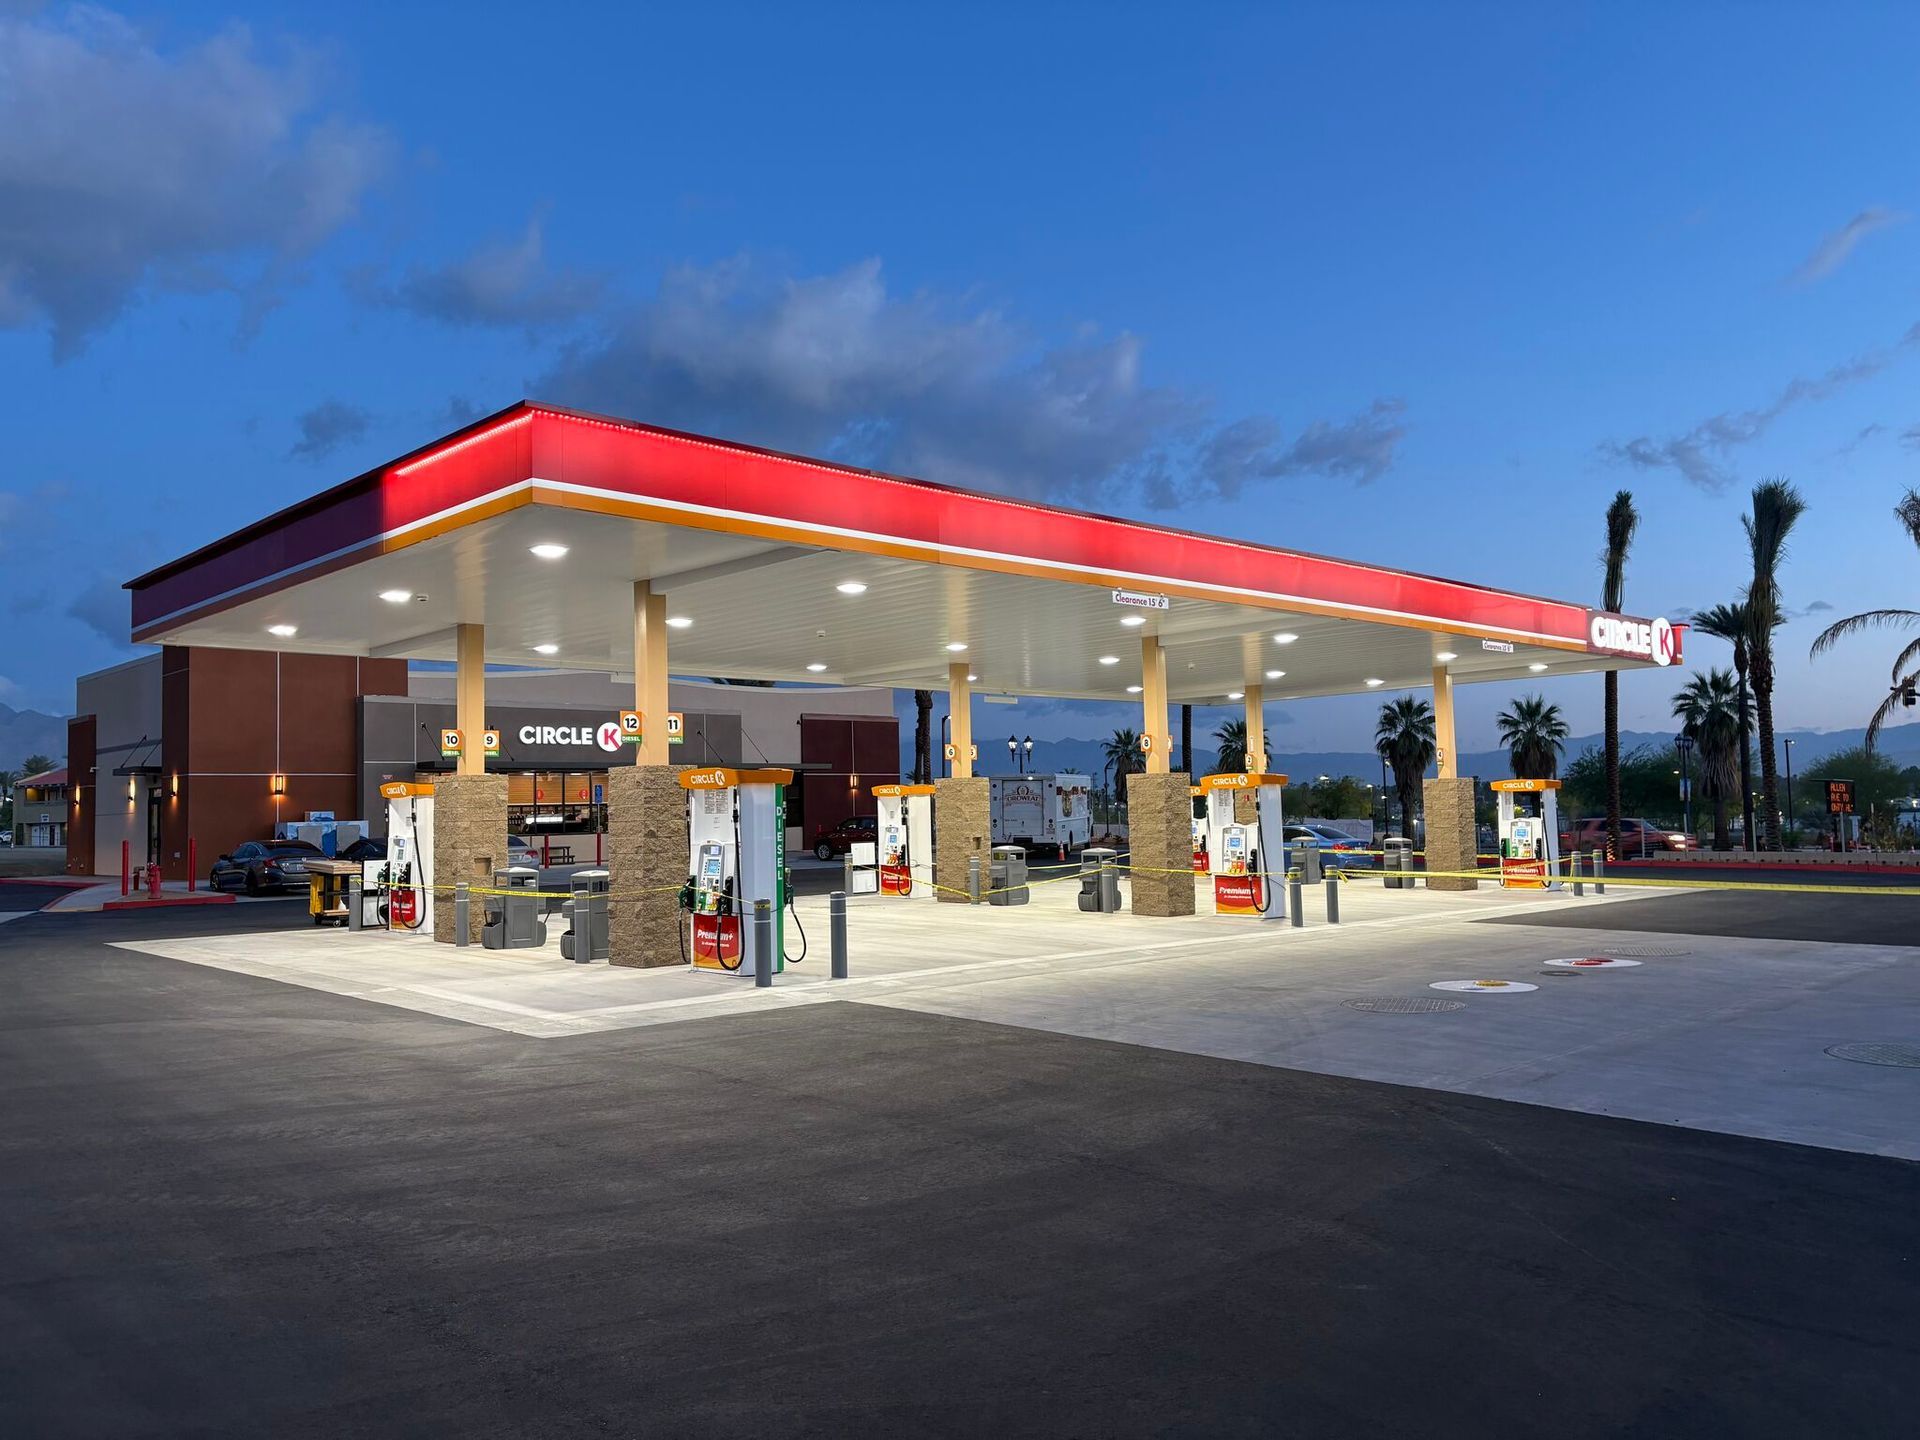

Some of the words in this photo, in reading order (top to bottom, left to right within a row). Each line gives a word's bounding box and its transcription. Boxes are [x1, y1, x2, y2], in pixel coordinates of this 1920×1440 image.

[1115, 593, 1147, 606] Clearance
[1591, 616, 1652, 654] CIRCLE
[625, 717, 638, 729] 12
[667, 719, 678, 730] 11
[445, 734, 458, 745] 10
[486, 735, 494, 745] 9
[518, 725, 593, 745] CIRCLE
[603, 728, 620, 749] K
[1144, 739, 1149, 747] 8
[690, 774, 716, 785] CIRCLE
[716, 771, 725, 786] K
[1212, 777, 1238, 786] CIRCLE
[1238, 775, 1248, 786] K
[776, 806, 784, 881] DIESEL
